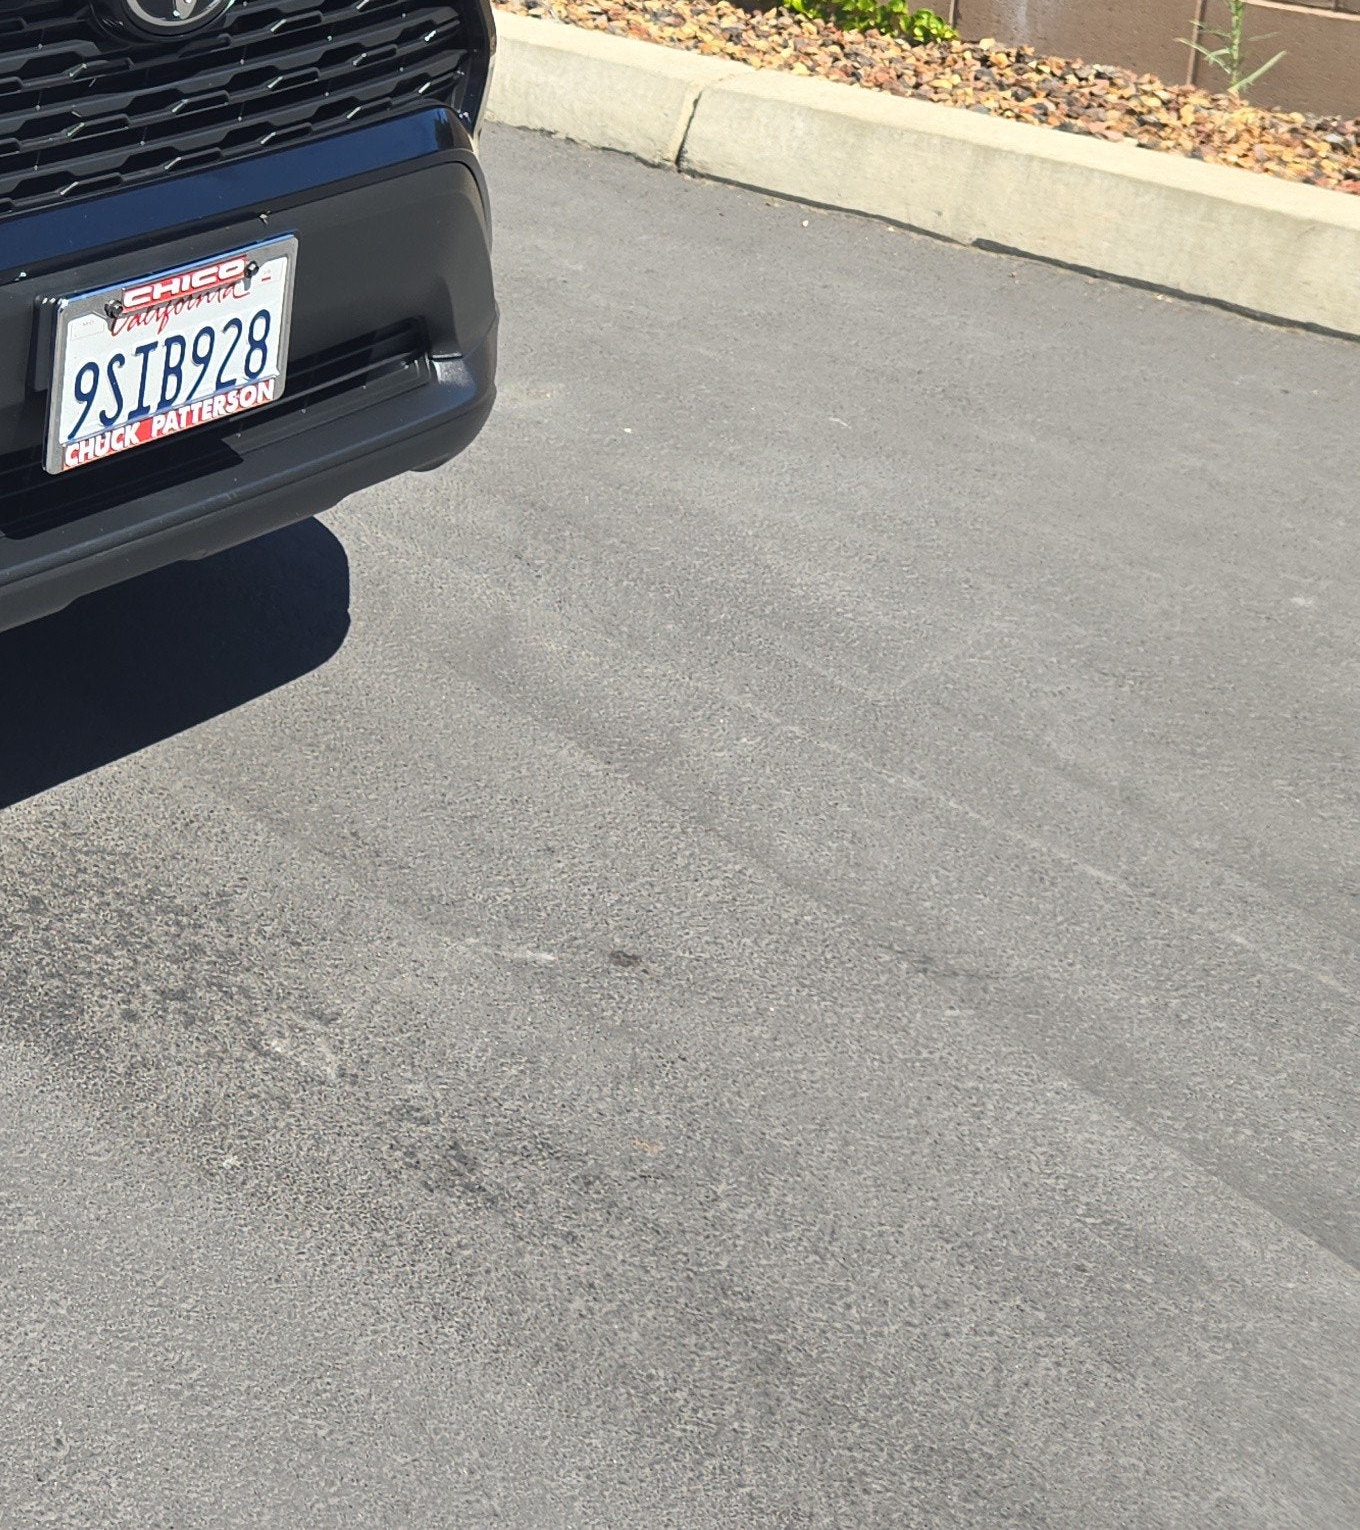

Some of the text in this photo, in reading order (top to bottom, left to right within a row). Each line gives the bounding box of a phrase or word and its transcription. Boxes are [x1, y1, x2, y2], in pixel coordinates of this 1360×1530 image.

[123, 258, 245, 308] CHICO
[67, 309, 271, 440] 9SIB928
[65, 378, 275, 467] CHUCK PATTERSON
